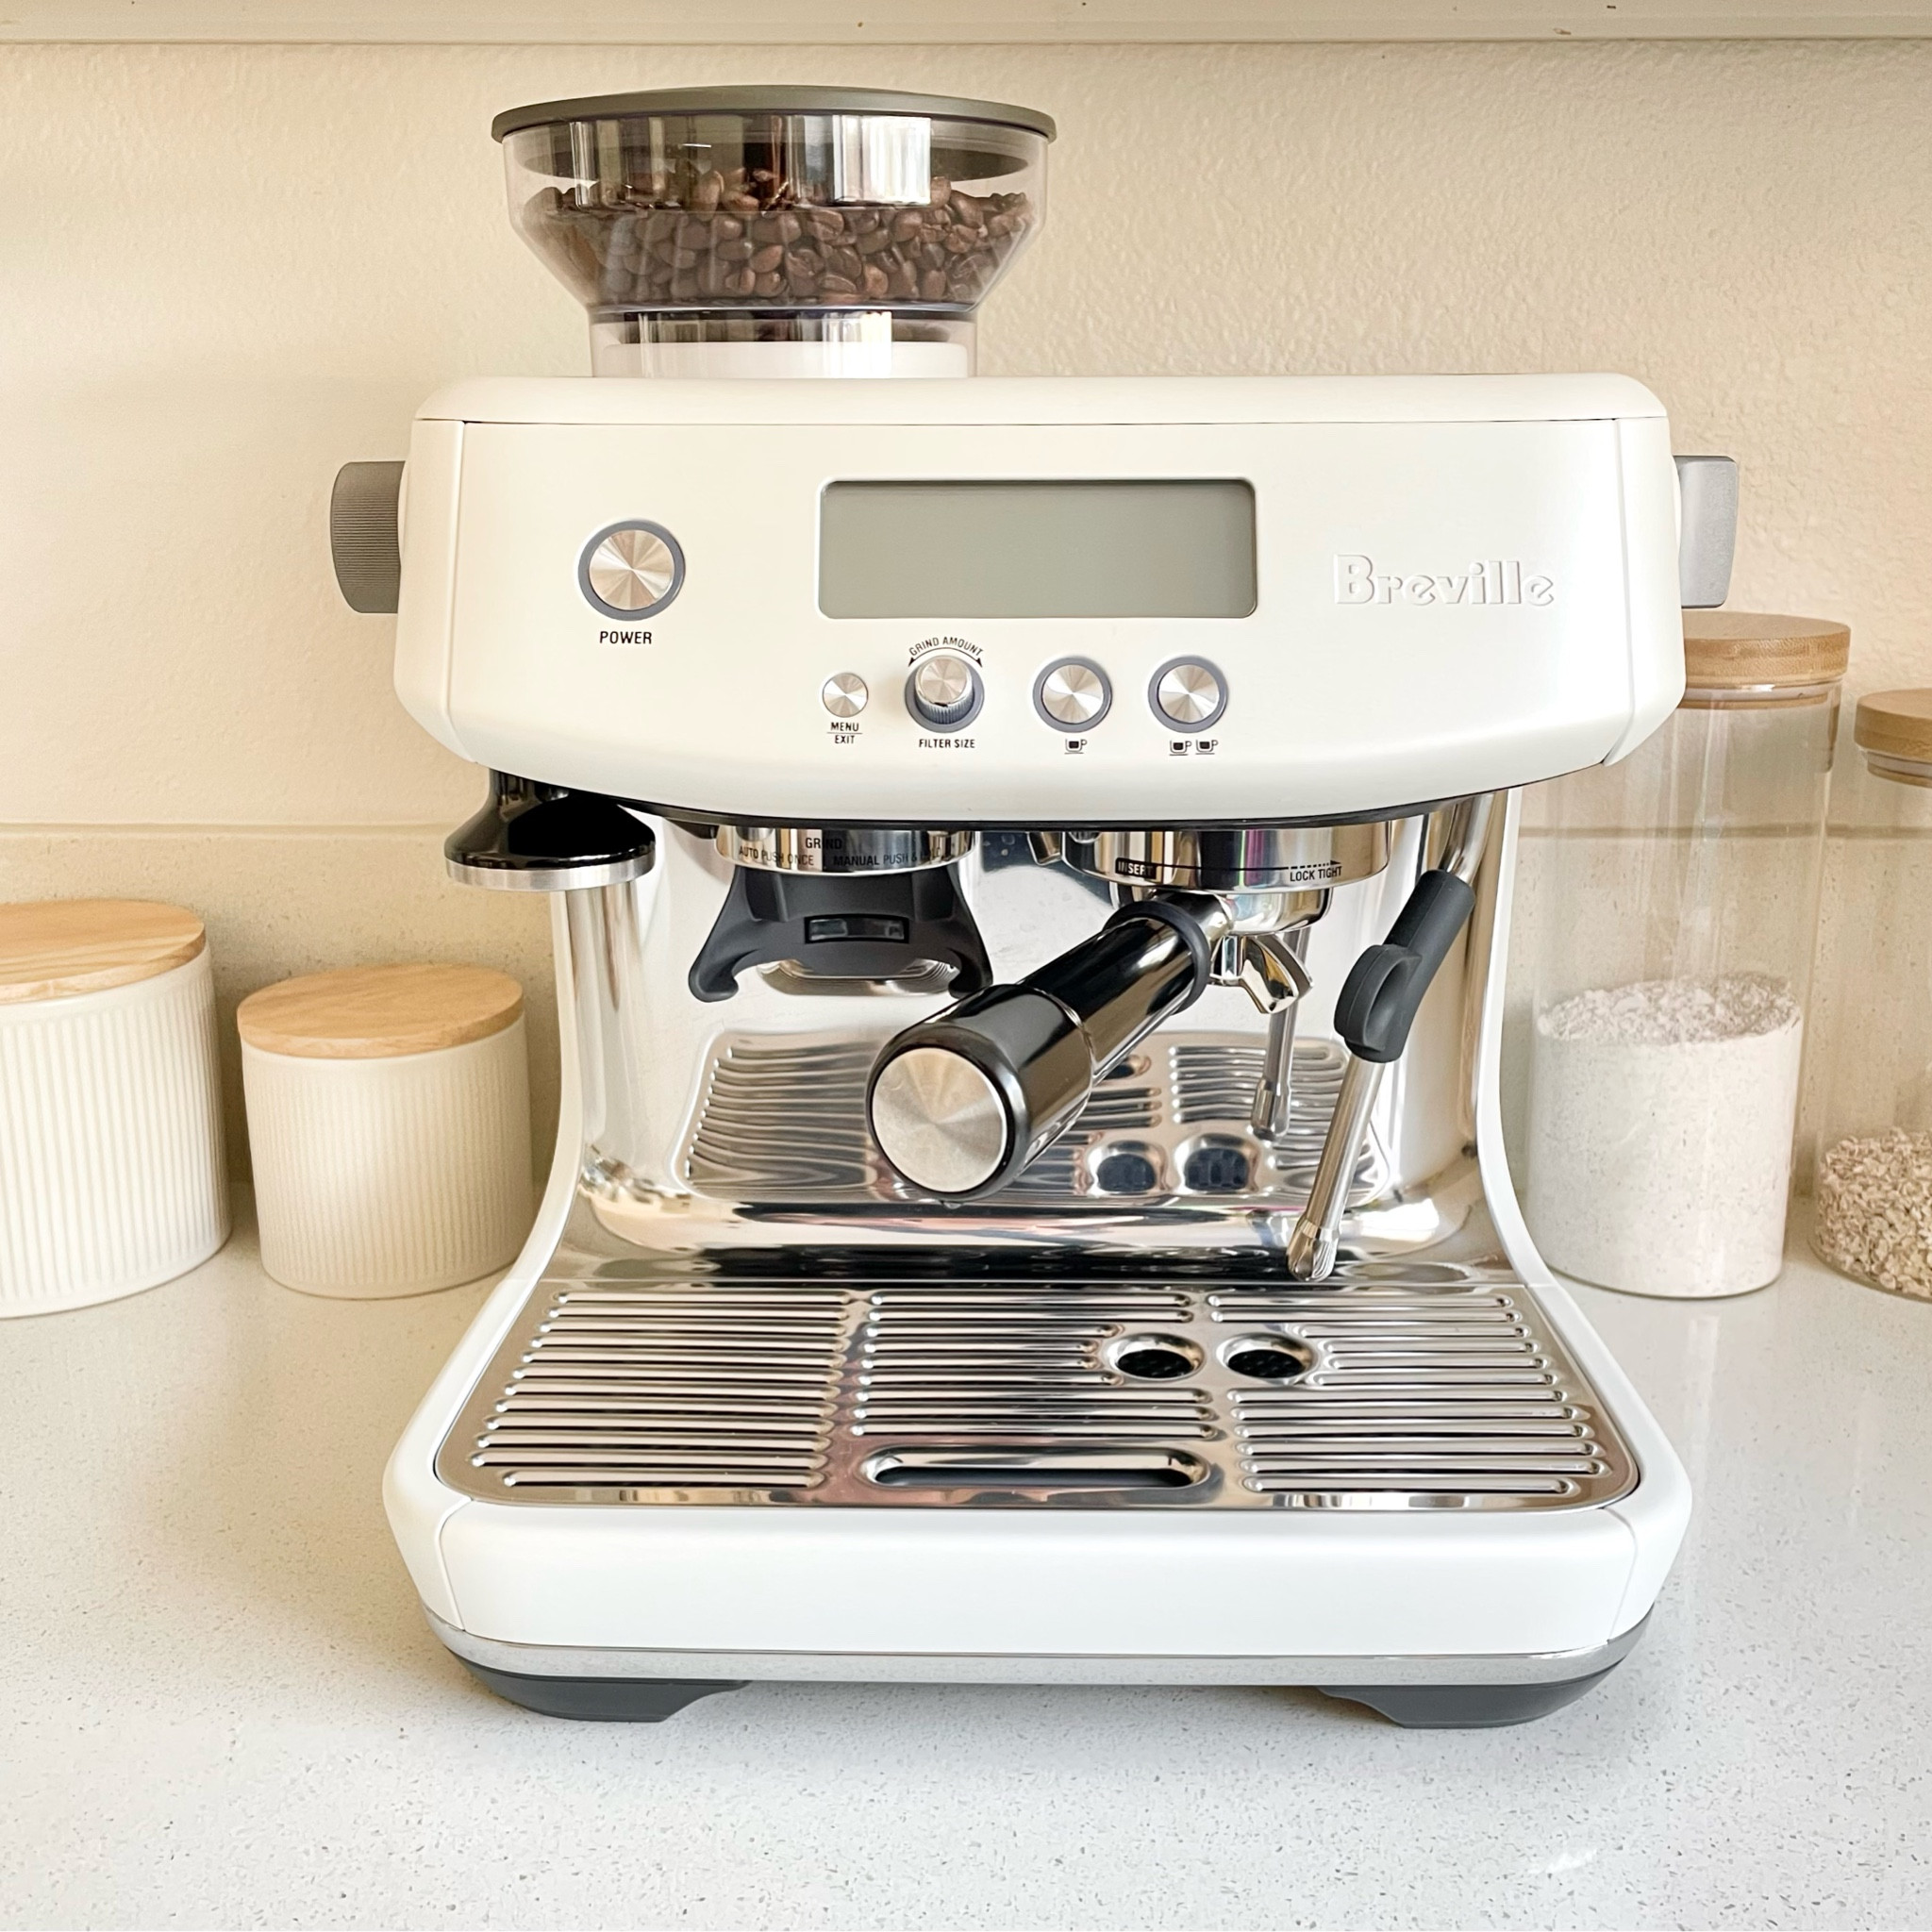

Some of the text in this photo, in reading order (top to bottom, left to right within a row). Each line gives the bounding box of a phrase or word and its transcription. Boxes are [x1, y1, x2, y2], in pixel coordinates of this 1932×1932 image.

[1334, 554, 1555, 607] Breville
[599, 630, 652, 644] POWER
[908, 636, 984, 657] GRIND AMOUNT
[830, 722, 859, 732] MENU
[834, 735, 855, 744] EXIT
[918, 739, 975, 748] FILTER SIZE
[739, 845, 814, 866] AUTO PUSH ONCE
[833, 855, 880, 866] MANUAL
[883, 853, 909, 865] PUSH
[1290, 866, 1342, 882] LOCK TIGHT
